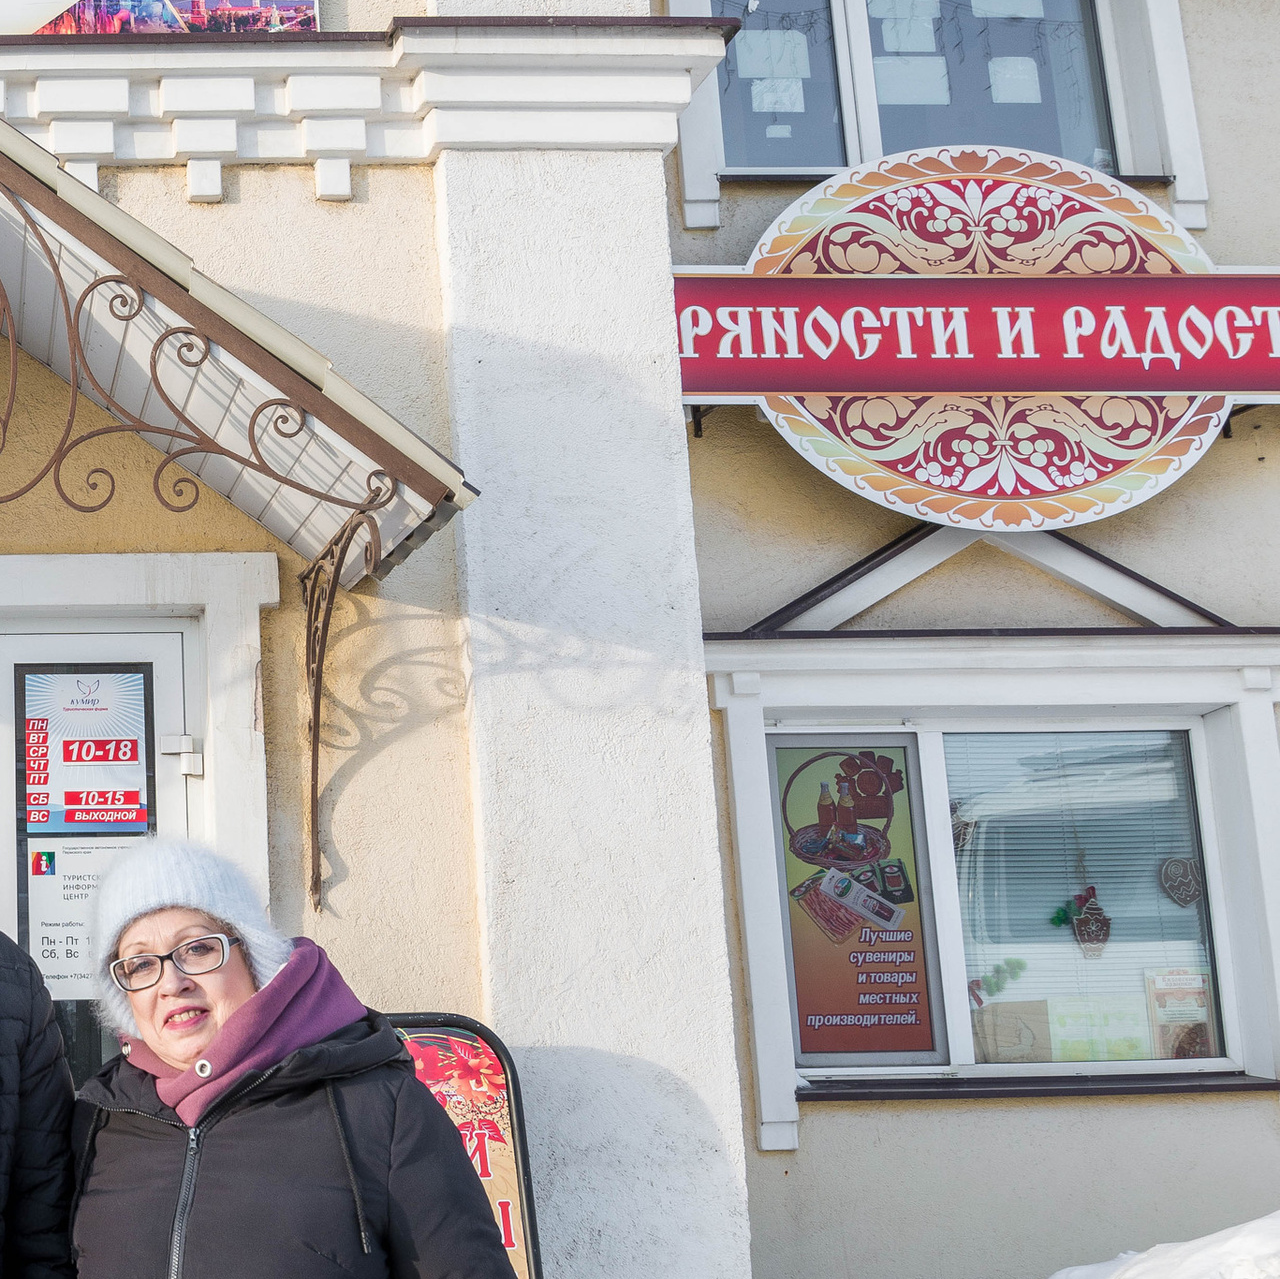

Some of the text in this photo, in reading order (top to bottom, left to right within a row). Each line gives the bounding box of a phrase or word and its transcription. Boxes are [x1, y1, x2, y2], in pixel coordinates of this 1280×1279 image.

[991, 305, 1041, 360] И
[28, 720, 47, 730] ПН
[28, 733, 46, 743] ВТ
[29, 746, 47, 757] СР
[68, 740, 132, 761] 10-18
[29, 760, 47, 770] ЧТ
[29, 774, 47, 784] ПТ
[30, 794, 48, 804] СБ
[79, 791, 125, 805] 10-15
[30, 811, 48, 821] ВС
[74, 809, 137, 822] ВЫХОДНОЙ
[63, 893, 90, 901] ЦЕНТР
[41, 936, 56, 946] Пн
[65, 936, 79, 946] Пт
[860, 927, 913, 946] Лучшие
[41, 948, 59, 960] Сб,
[65, 948, 79, 959] Вс
[849, 951, 915, 966] сувениры
[857, 972, 917, 987] и товары
[859, 993, 919, 1004] местных
[807, 1010, 920, 1030] производителей.
